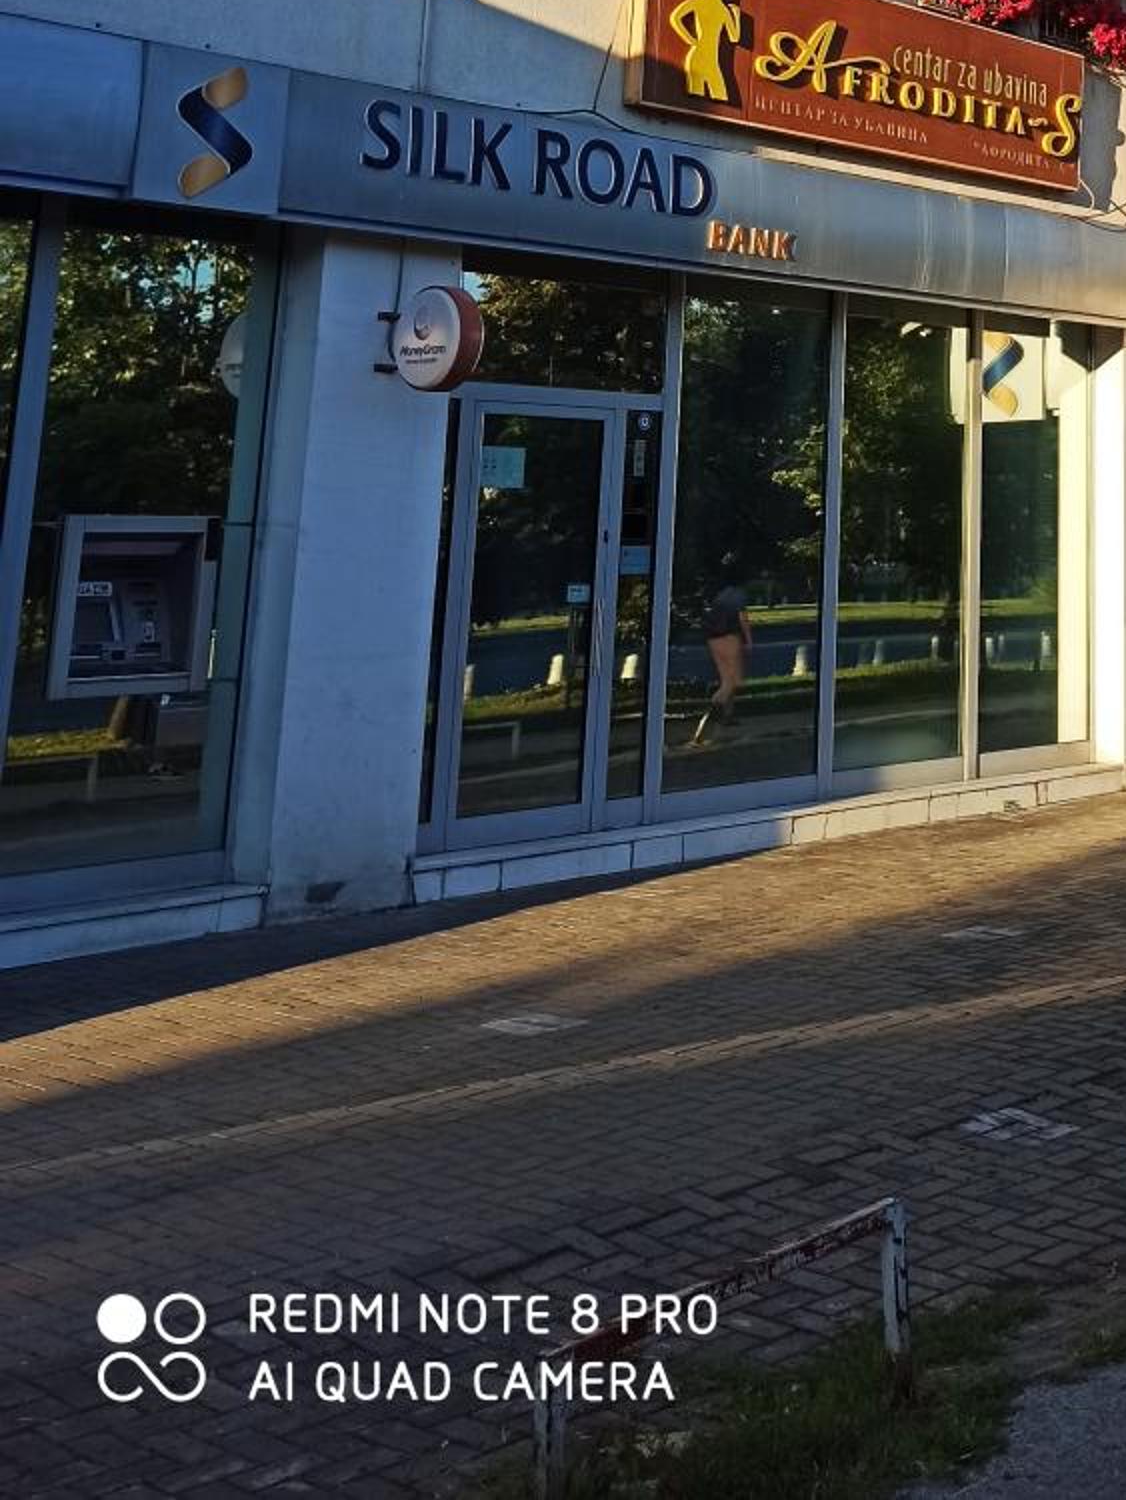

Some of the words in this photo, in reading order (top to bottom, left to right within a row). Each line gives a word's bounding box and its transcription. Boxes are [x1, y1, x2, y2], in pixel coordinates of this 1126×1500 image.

[893, 45, 951, 83] centar
[957, 60, 977, 91] za
[982, 61, 1048, 107] ubavina
[359, 100, 513, 191] SILK
[531, 127, 718, 217] ROAD
[706, 219, 799, 262] BANK
